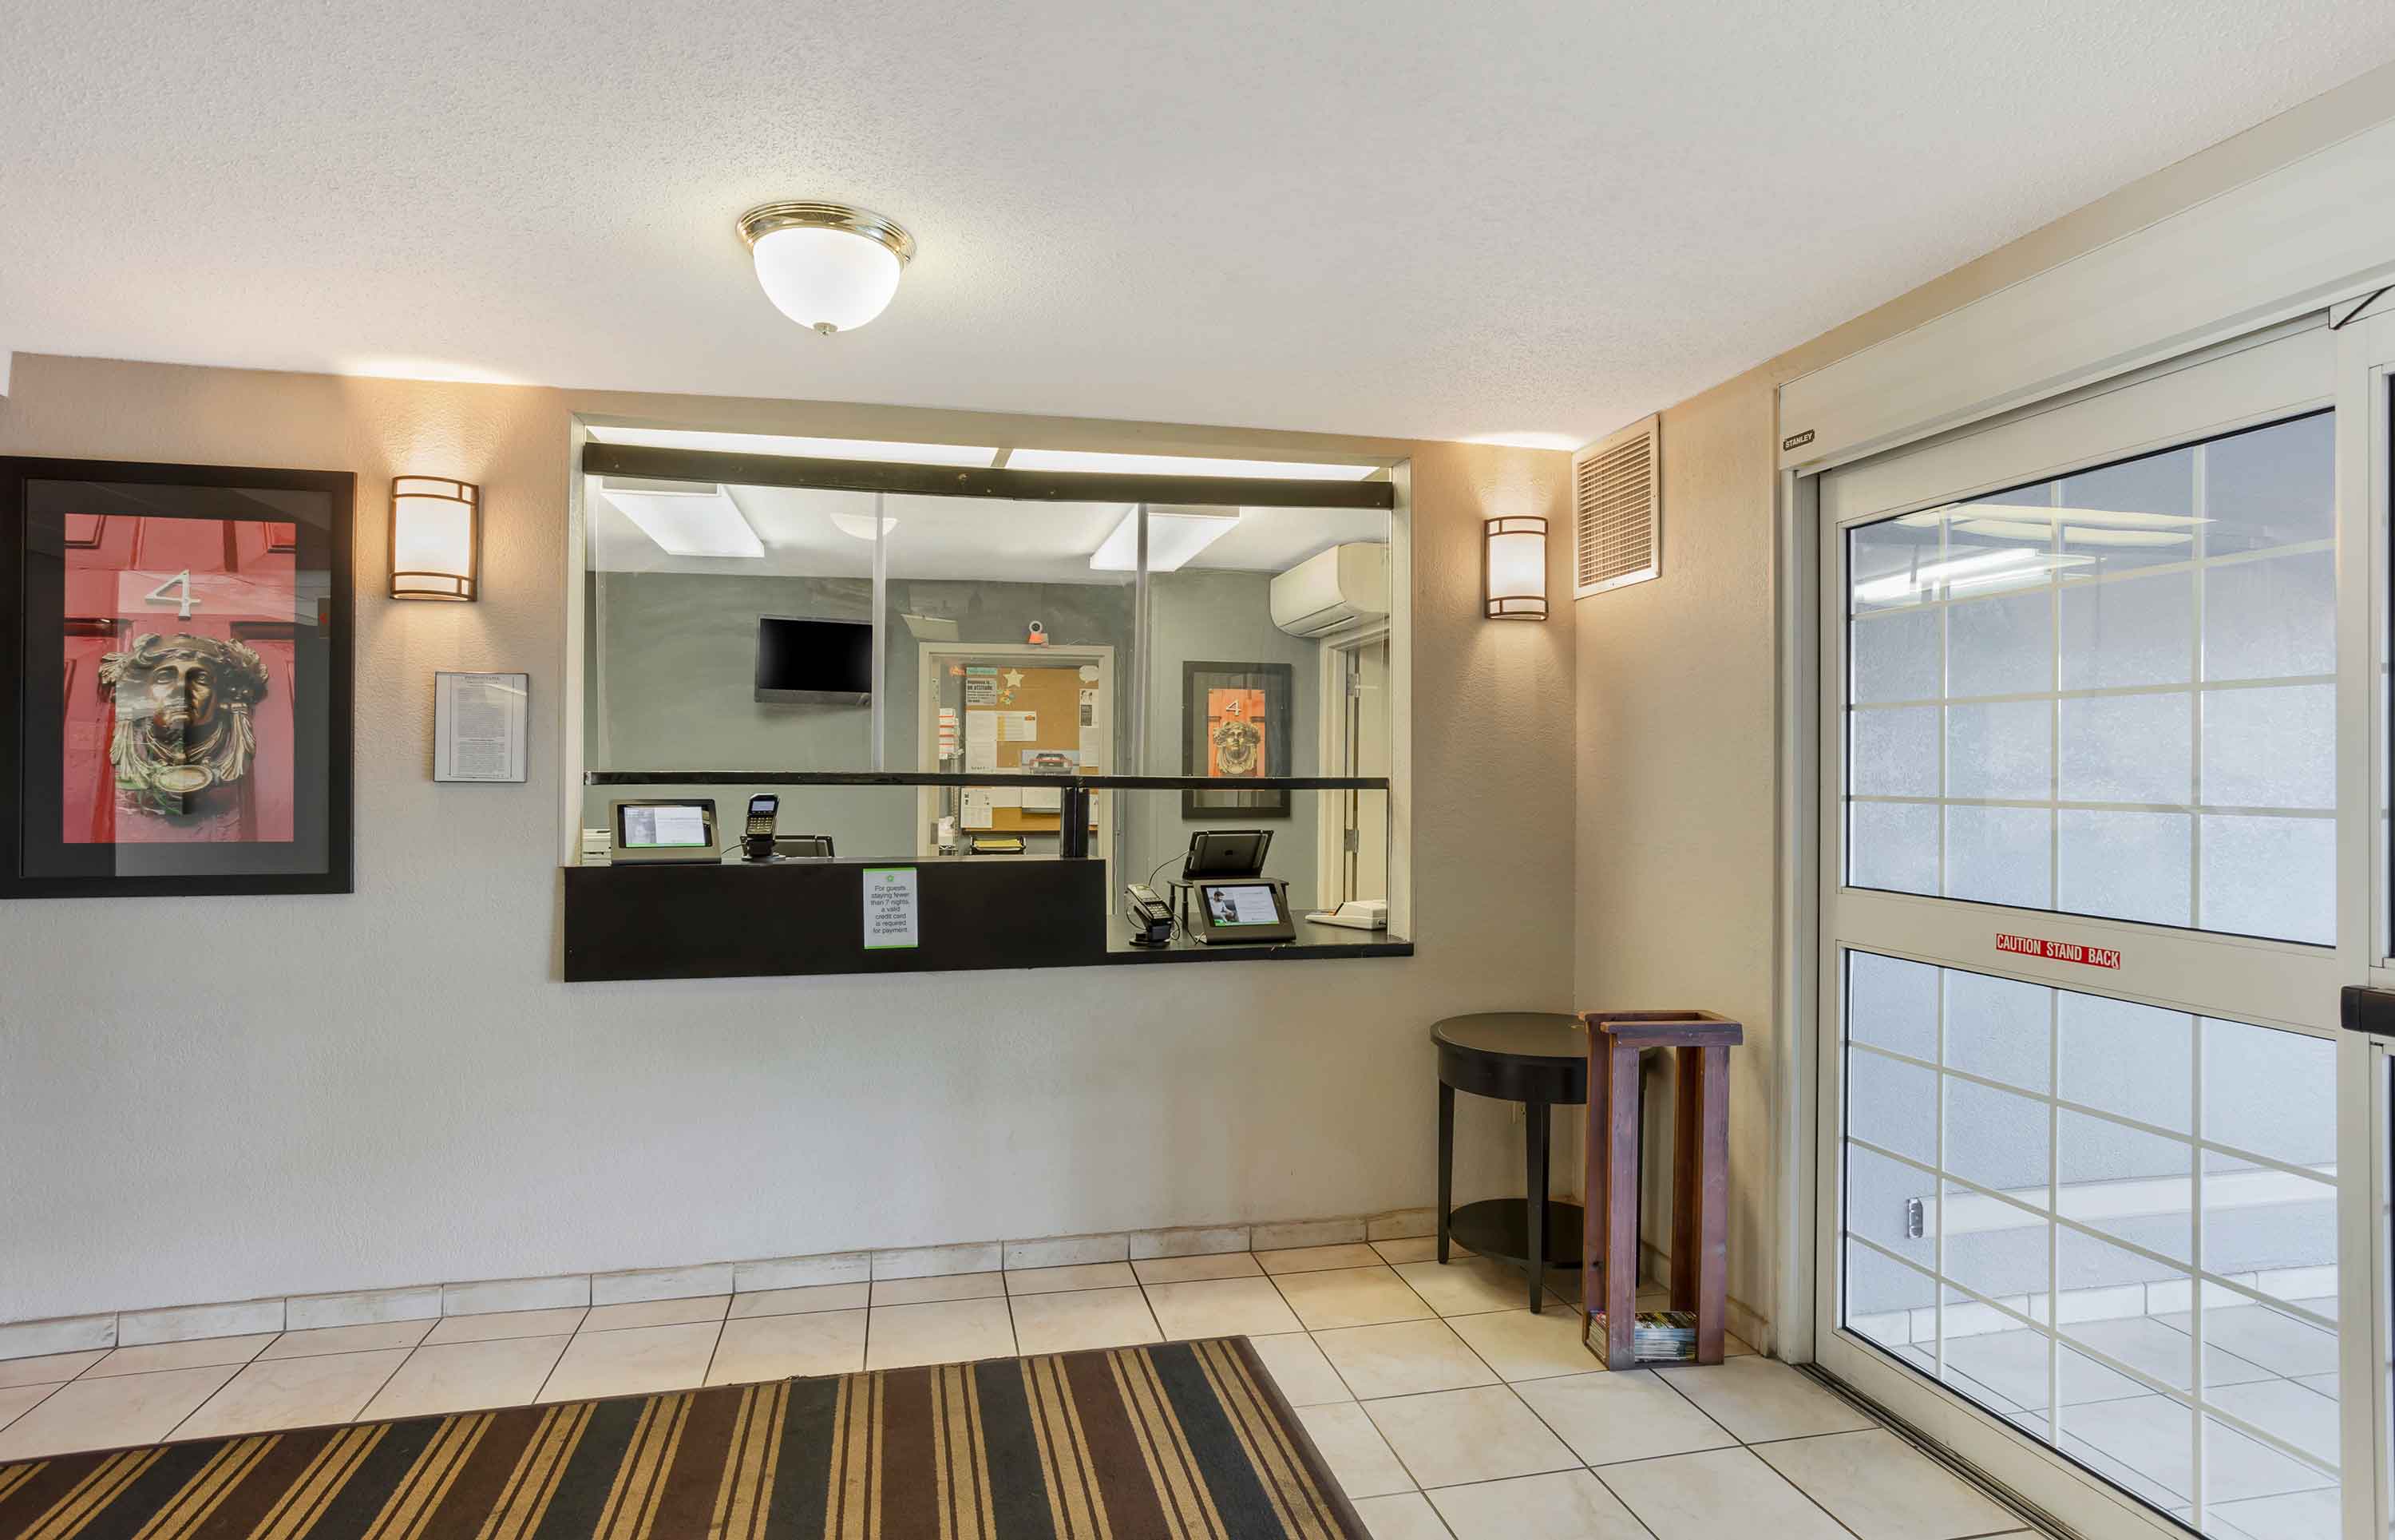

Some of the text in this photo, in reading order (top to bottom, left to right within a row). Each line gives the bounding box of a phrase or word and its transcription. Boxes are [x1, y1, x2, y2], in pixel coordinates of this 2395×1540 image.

[144, 568, 201, 621] 4
[1225, 698, 1241, 717] 4
[1997, 934, 2120, 969] CAUTION STAND BACK
